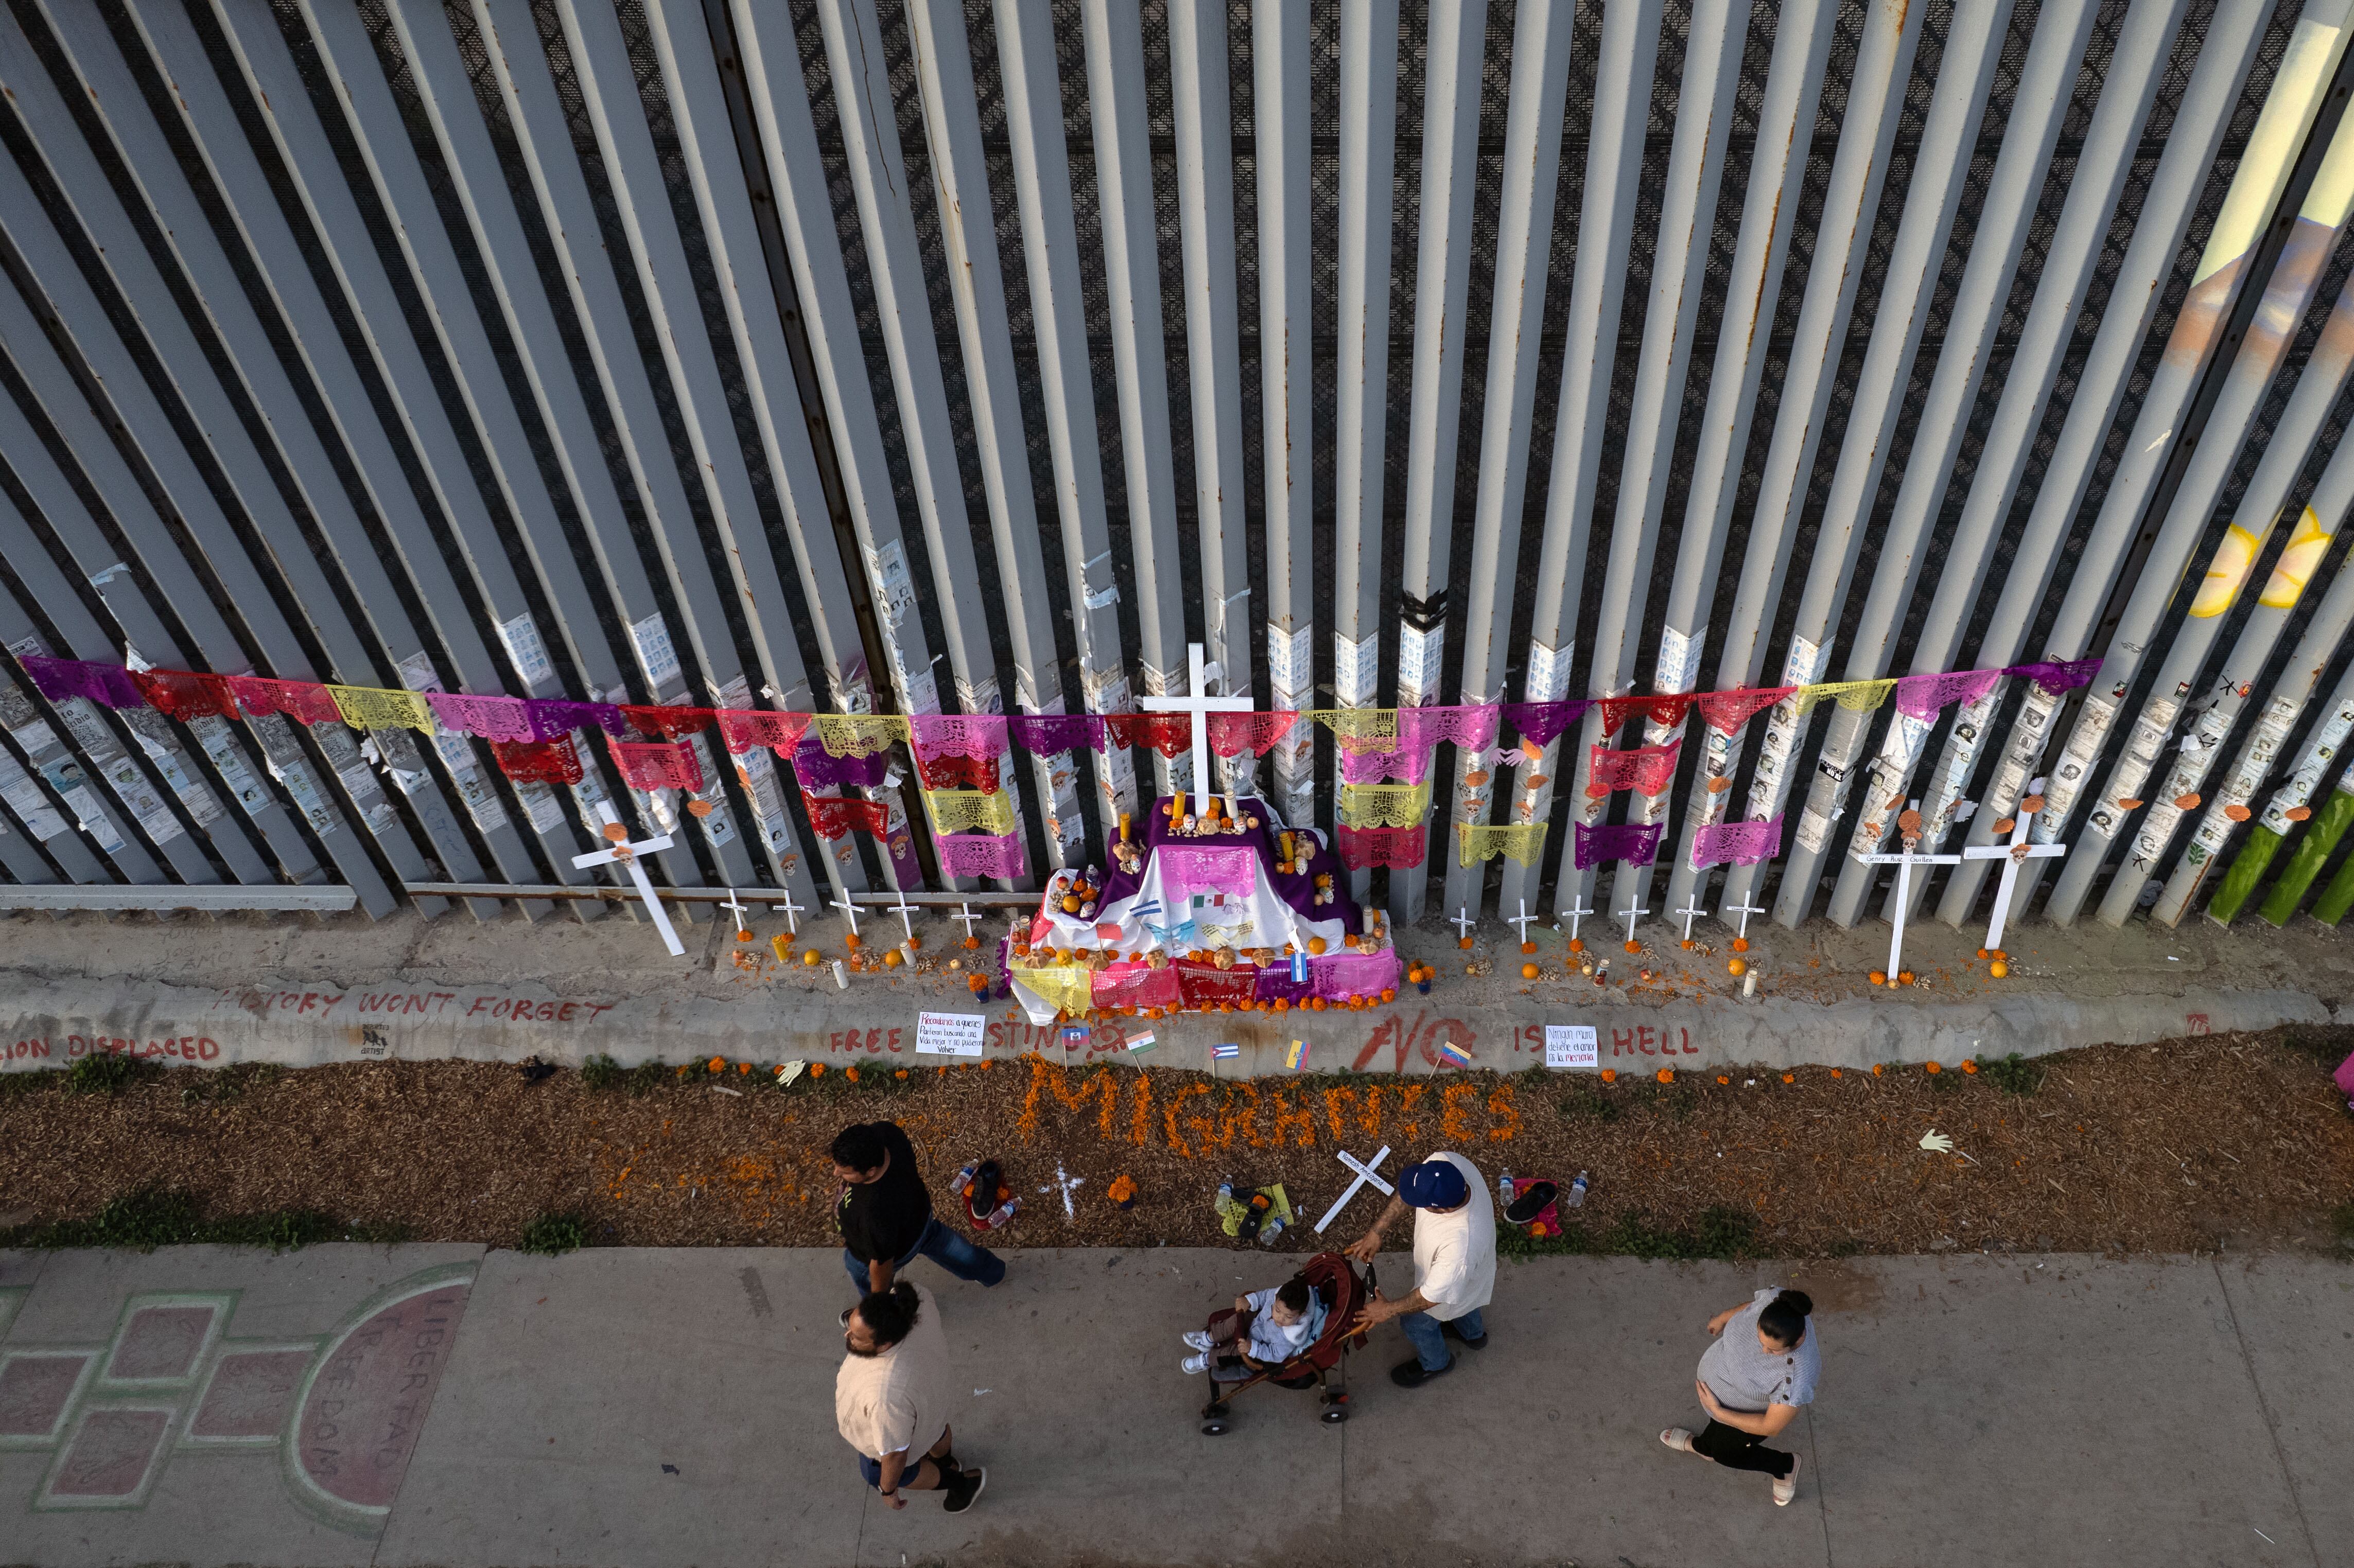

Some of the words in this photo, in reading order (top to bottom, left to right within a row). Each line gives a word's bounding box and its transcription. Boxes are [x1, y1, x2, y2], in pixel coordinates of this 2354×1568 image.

[466, 996, 614, 1025] FORGET
[921, 1013, 954, 1026] Recordamos
[944, 1028, 966, 1037] buscando
[1576, 1030, 1593, 1040] muro
[830, 1028, 902, 1053] FREE
[962, 1038, 984, 1047] pudieron
[1548, 1041, 1572, 1051] detiene
[1573, 1043, 1579, 1051] el
[1580, 1043, 1596, 1051] amor
[1612, 1026, 1699, 1057] HELL
[0, 1037, 50, 1060] ION
[68, 1034, 220, 1061] DISPLACED
[1557, 1052, 1564, 1062] la
[1565, 1053, 1594, 1063] memoria
[1342, 1153, 1359, 1169] Ramesh
